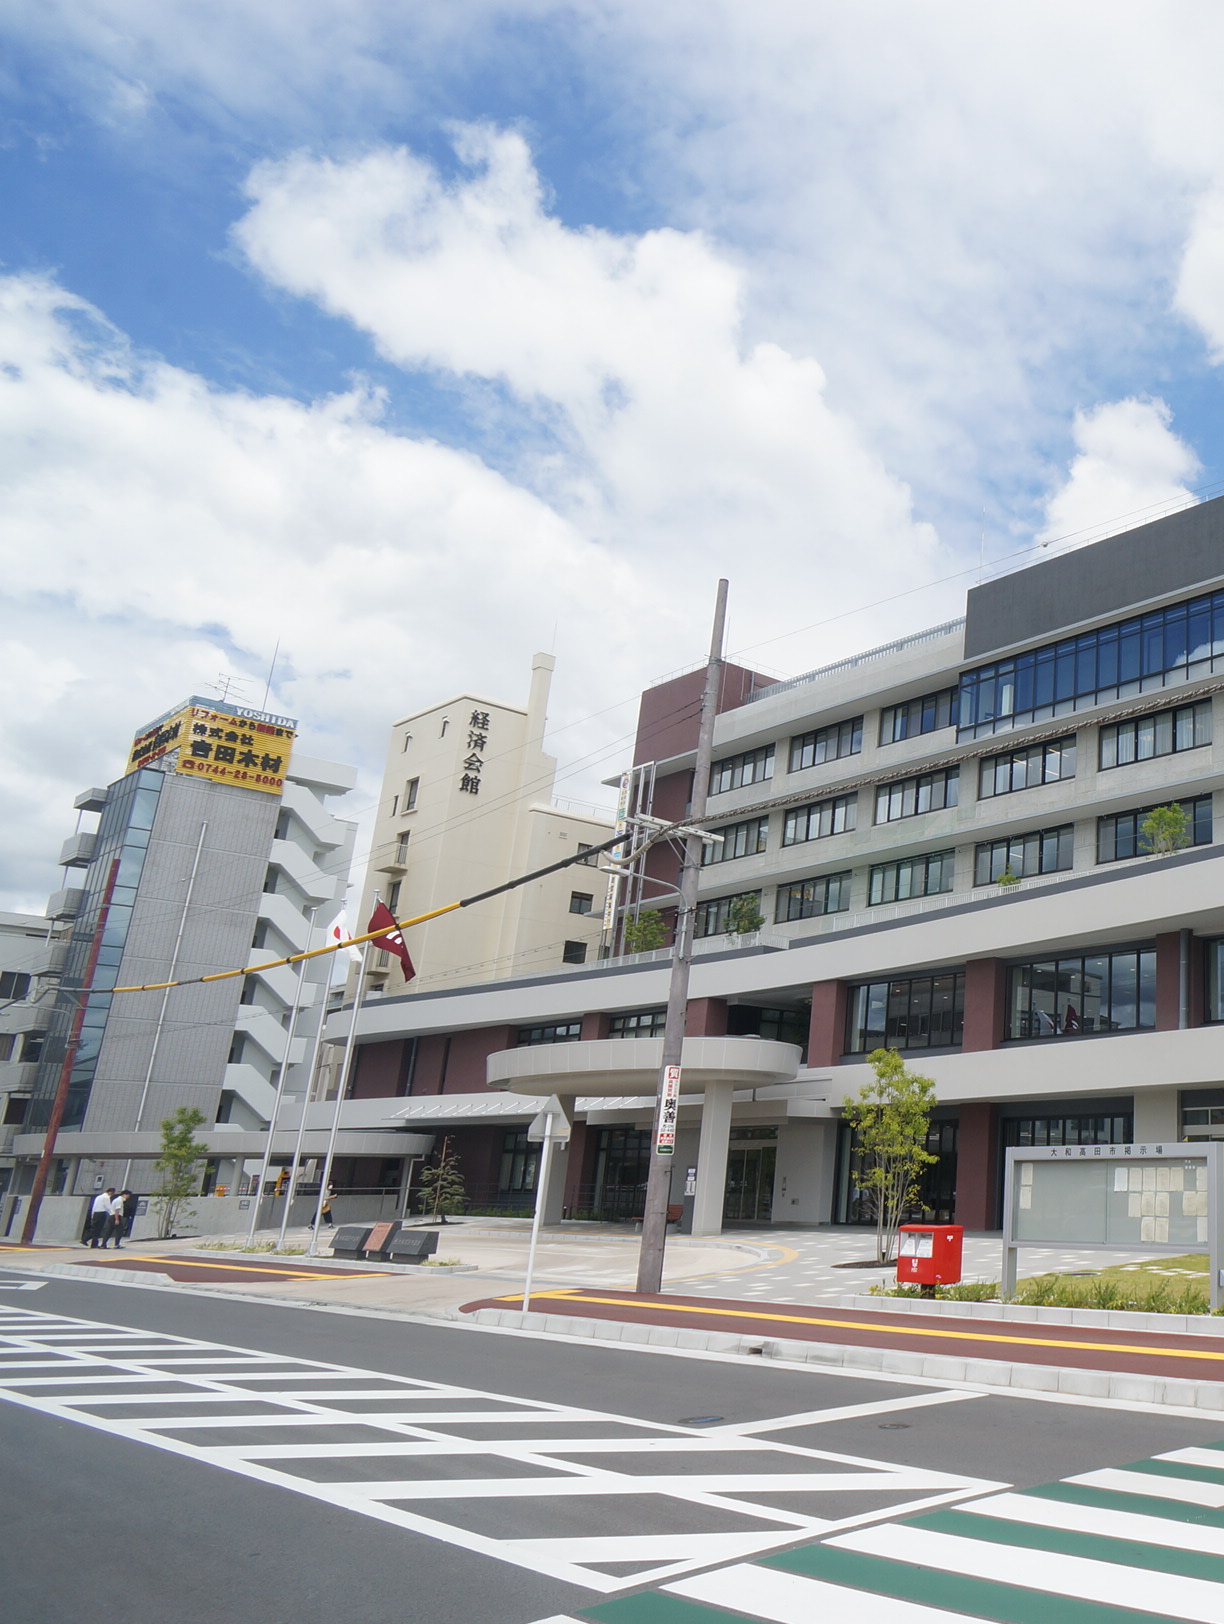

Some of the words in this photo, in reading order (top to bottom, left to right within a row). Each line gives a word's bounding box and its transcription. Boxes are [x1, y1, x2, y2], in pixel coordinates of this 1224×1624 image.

[236, 706, 295, 728] YOSHIDA
[192, 722, 254, 746] 株式会社
[459, 709, 490, 795] 経済会館
[198, 762, 282, 787] 0744-28-5000
[664, 1098, 676, 1123] 奥善
[1050, 1145, 1163, 1157] 大和高田市掲示場
